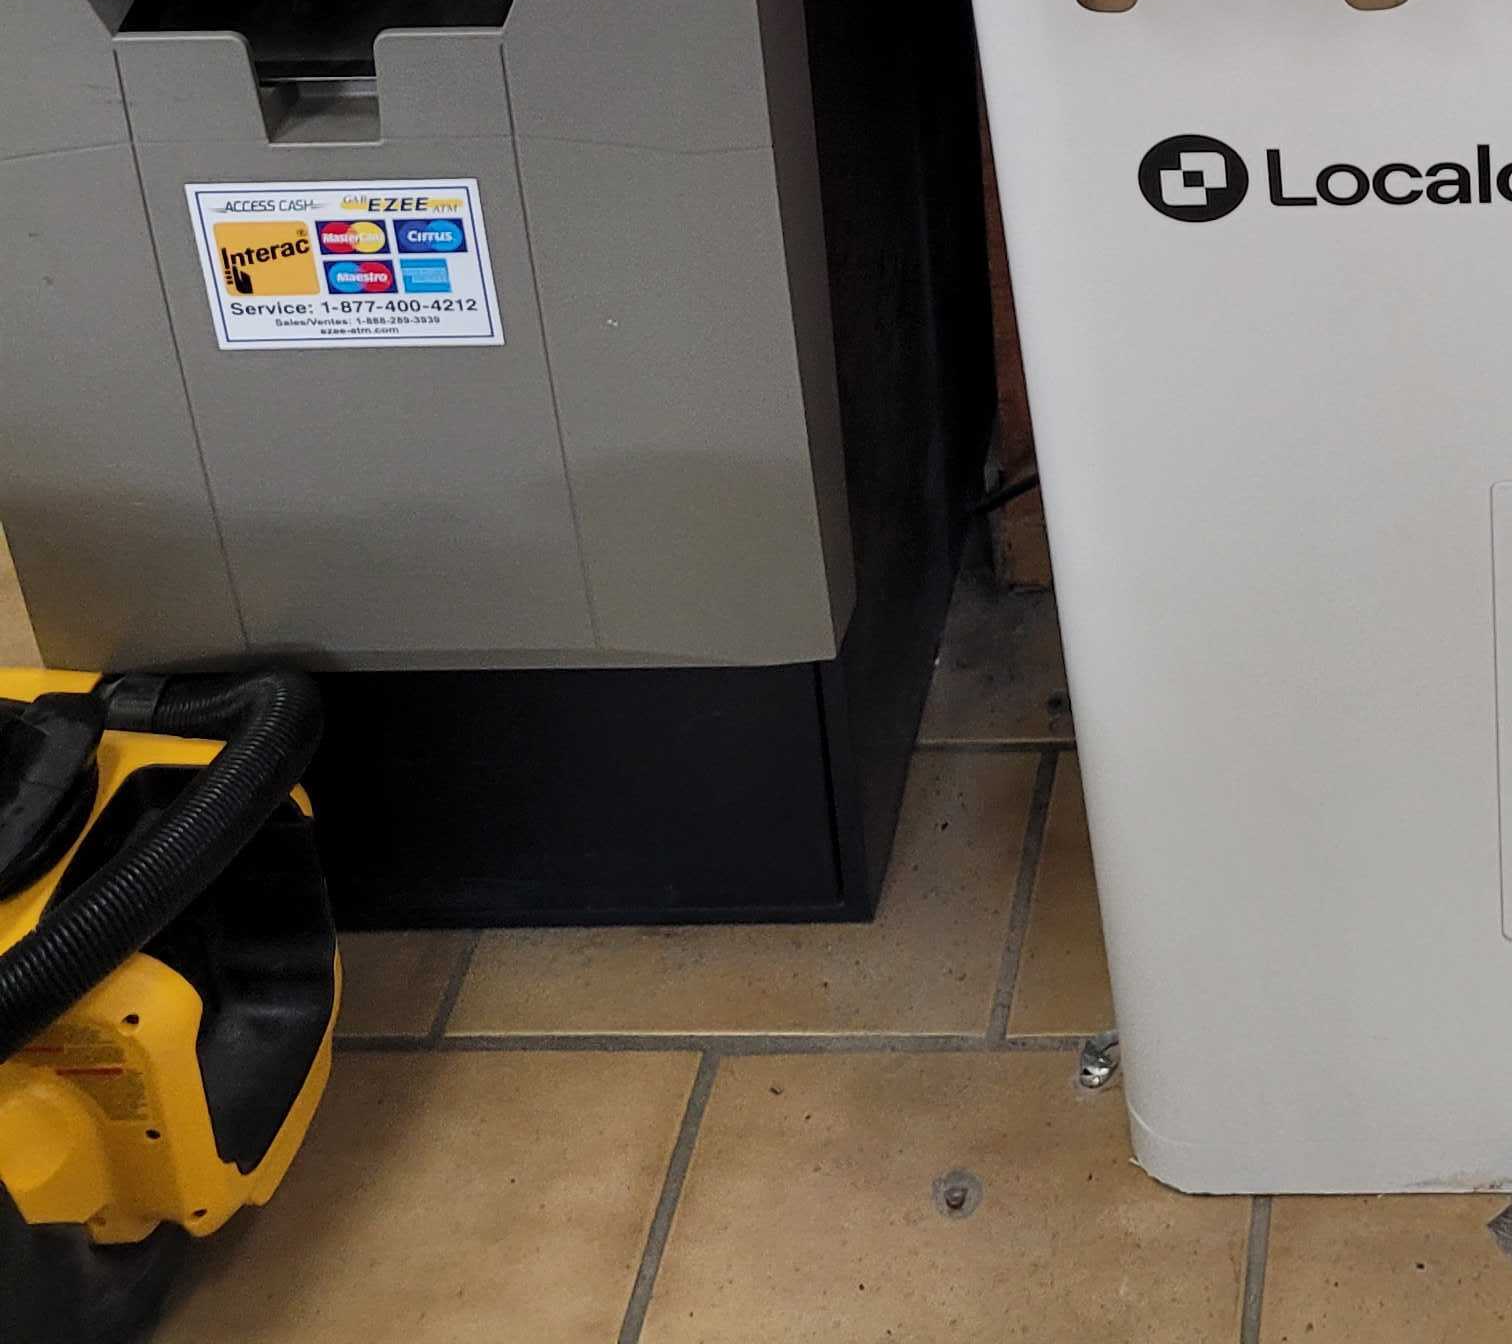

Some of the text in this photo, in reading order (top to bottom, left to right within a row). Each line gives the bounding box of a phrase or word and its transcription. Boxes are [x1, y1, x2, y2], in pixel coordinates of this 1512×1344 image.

[224, 199, 314, 213] ACCESS CASH
[367, 197, 429, 213] EZEE
[322, 232, 386, 244] MasterCard
[407, 230, 453, 242] Cirrus
[221, 237, 310, 270] Interac
[336, 272, 388, 283] Maestro
[231, 299, 479, 317] Service: 1-877-400-4212
